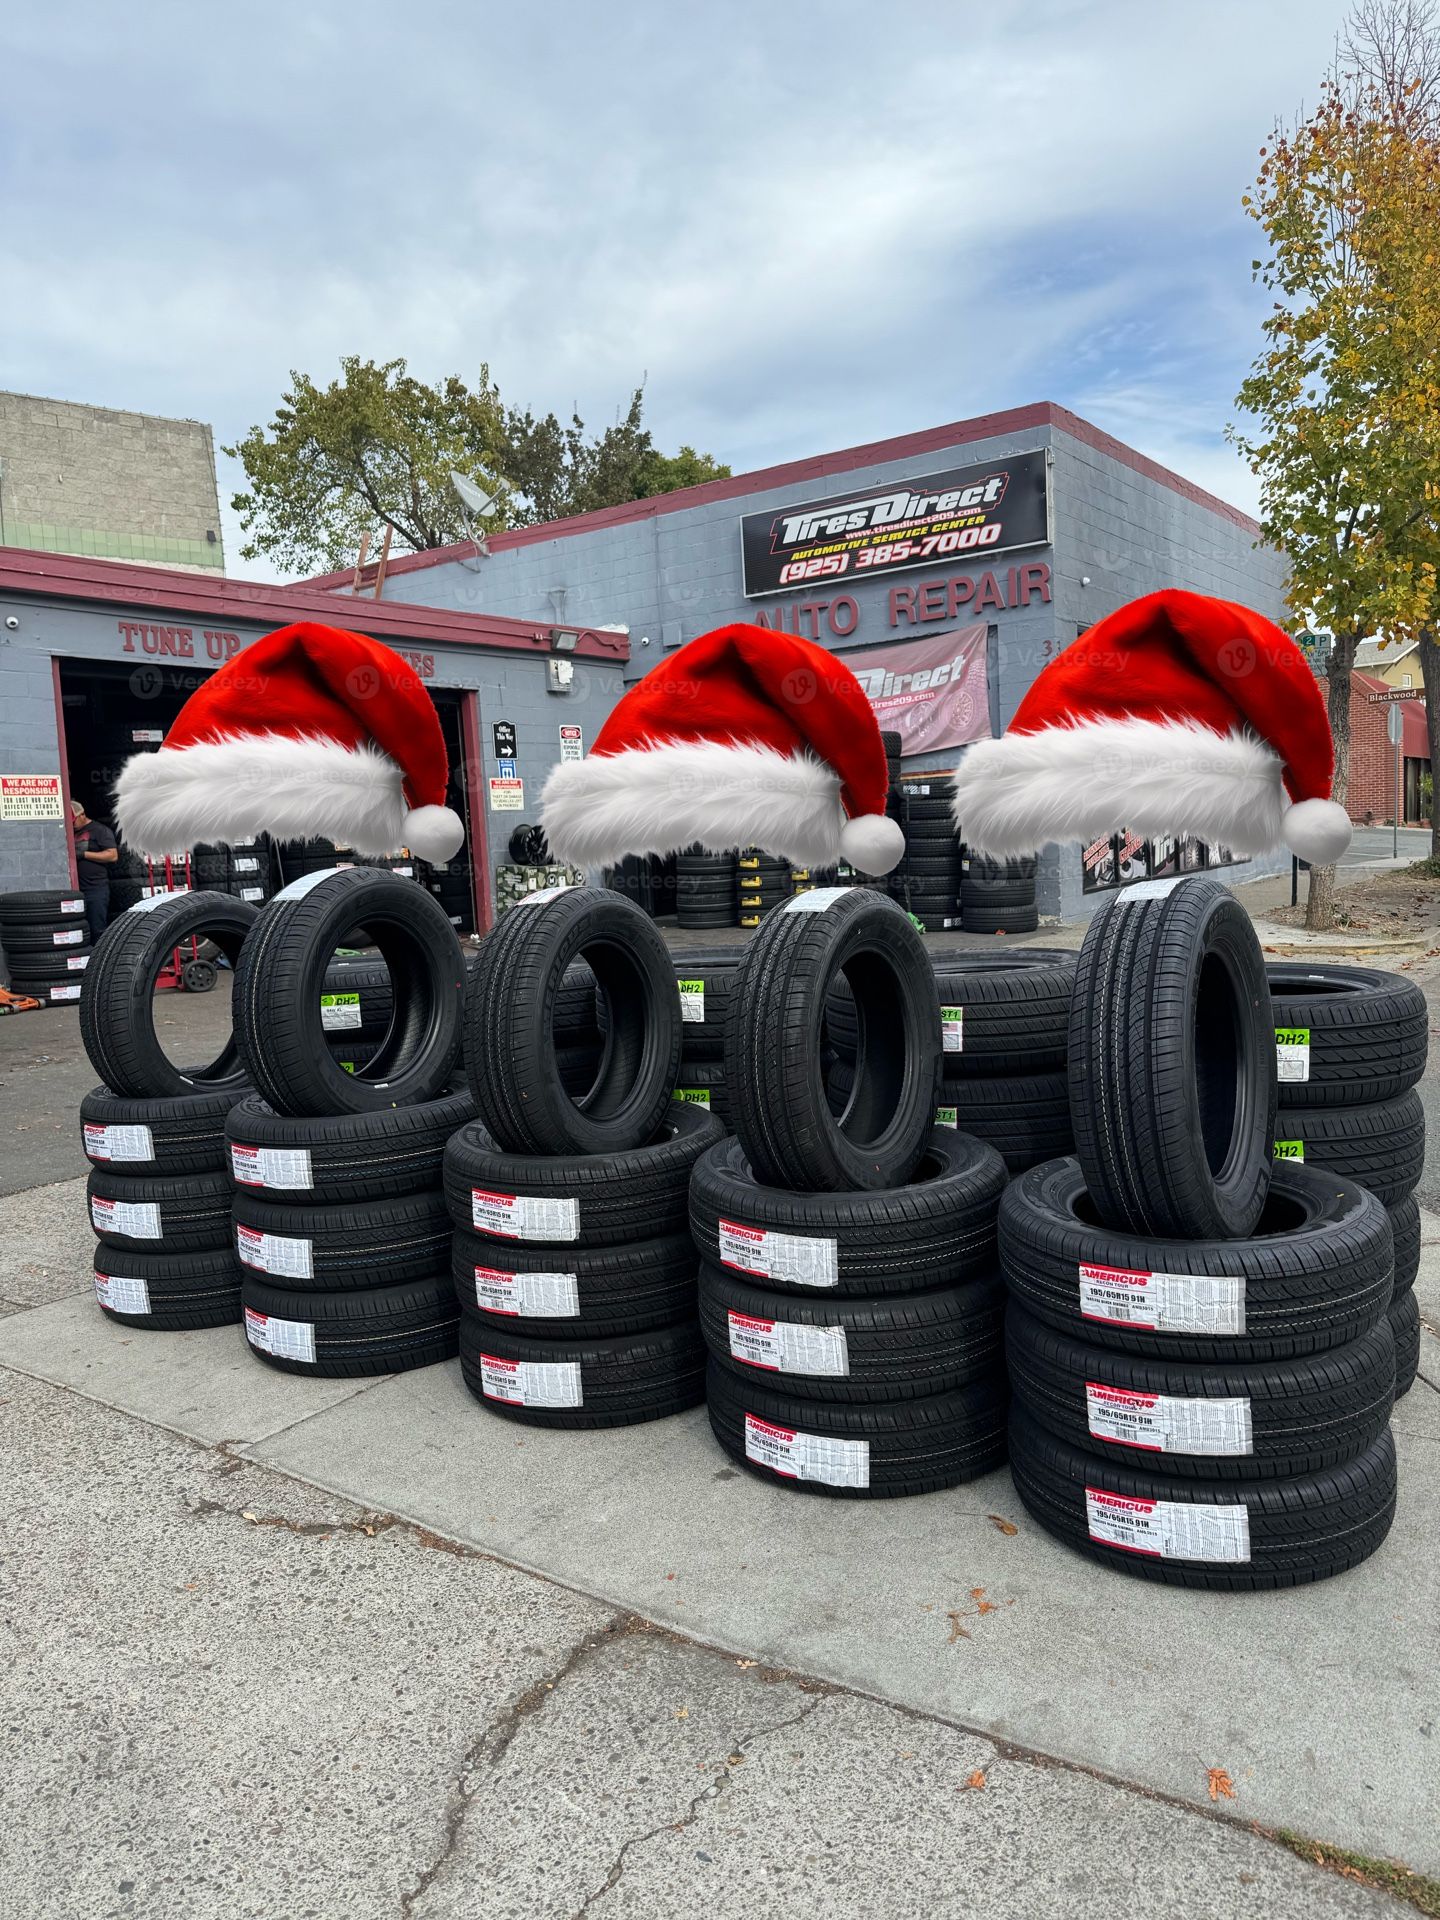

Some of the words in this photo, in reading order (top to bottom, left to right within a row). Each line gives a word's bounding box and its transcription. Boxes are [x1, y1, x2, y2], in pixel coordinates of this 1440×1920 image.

[782, 503, 868, 545] Tires
[869, 478, 1002, 526] Direct
[845, 507, 982, 540] www.tiresdirect209.com
[791, 538, 868, 561] AUTOMOTIVE
[872, 527, 924, 545] SERVICE
[927, 515, 987, 535] CENTER
[779, 553, 850, 584] (925)
[855, 523, 1002, 568] 385-7000
[889, 562, 1052, 627] REPAIR
[118, 621, 194, 657] TUNE
[204, 630, 241, 661] UP
[1319, 637, 1327, 646] P
[1369, 690, 1417, 702] Blackwood
[505, 733, 514, 742] Way
[4, 787, 58, 795] RESPONSIBLE
[7, 779, 20, 787] WE
[21, 779, 37, 787] ARE
[680, 984, 701, 993] DH2
[336, 997, 356, 1006] DH2
[941, 1010, 958, 1018] ST1
[1276, 1034, 1306, 1045] DH2
[684, 1093, 707, 1102] DH2
[474, 1193, 513, 1207] AMERICUS
[720, 1224, 763, 1242] AMERICUS
[475, 1271, 513, 1283] AMERICUS
[1080, 1268, 1148, 1287] AMERICUS
[1090, 1287, 1130, 1302] 195/65R15
[1131, 1294, 1146, 1304] 91H
[730, 1316, 772, 1333] AMERICUS
[482, 1358, 517, 1372] AMERICUS
[1088, 1388, 1156, 1409] AMERICUS
[1098, 1408, 1137, 1423] 195/65R15
[1138, 1416, 1153, 1425] 91H
[747, 1420, 793, 1442] AMERICUS
[1088, 1492, 1154, 1514] AMERICUS
[1101, 1504, 1119, 1513] RECON
[1120, 1508, 1133, 1516] TOUR
[1096, 1509, 1134, 1525] 195/65R15
[1135, 1519, 1150, 1529] 91H
